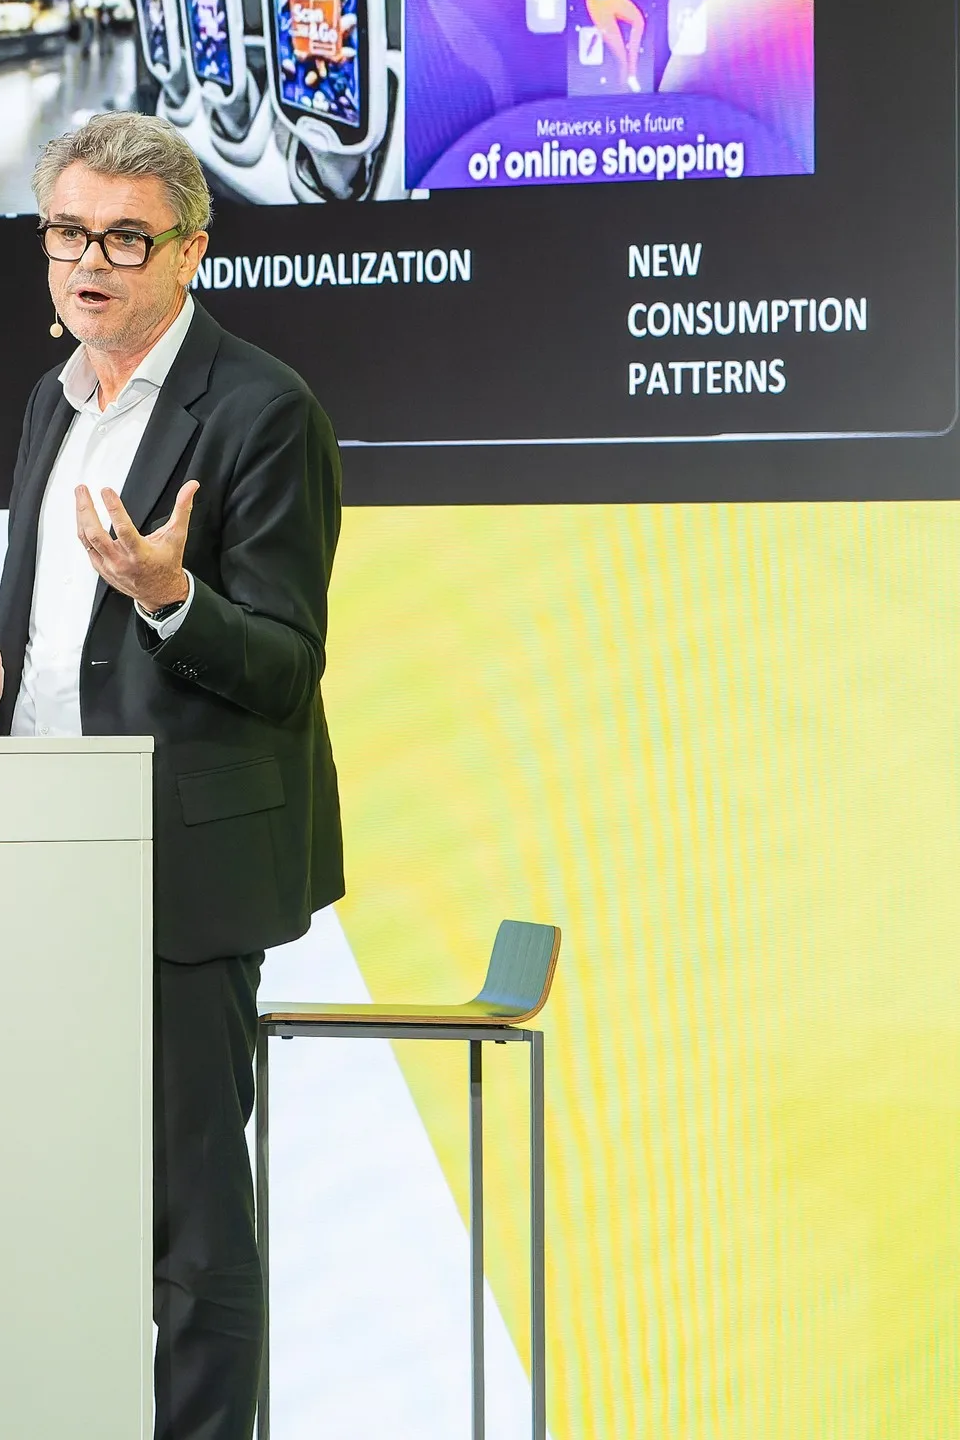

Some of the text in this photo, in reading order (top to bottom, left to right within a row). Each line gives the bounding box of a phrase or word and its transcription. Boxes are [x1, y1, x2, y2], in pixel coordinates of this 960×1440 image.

[536, 113, 685, 136] Metaverse is the future
[468, 133, 746, 181] of online shopping
[190, 248, 471, 291] NDIVIDUALIZATION
[628, 242, 703, 279] NEW
[627, 297, 867, 338] CONSUMPTION
[628, 358, 787, 396] PATTERNS
